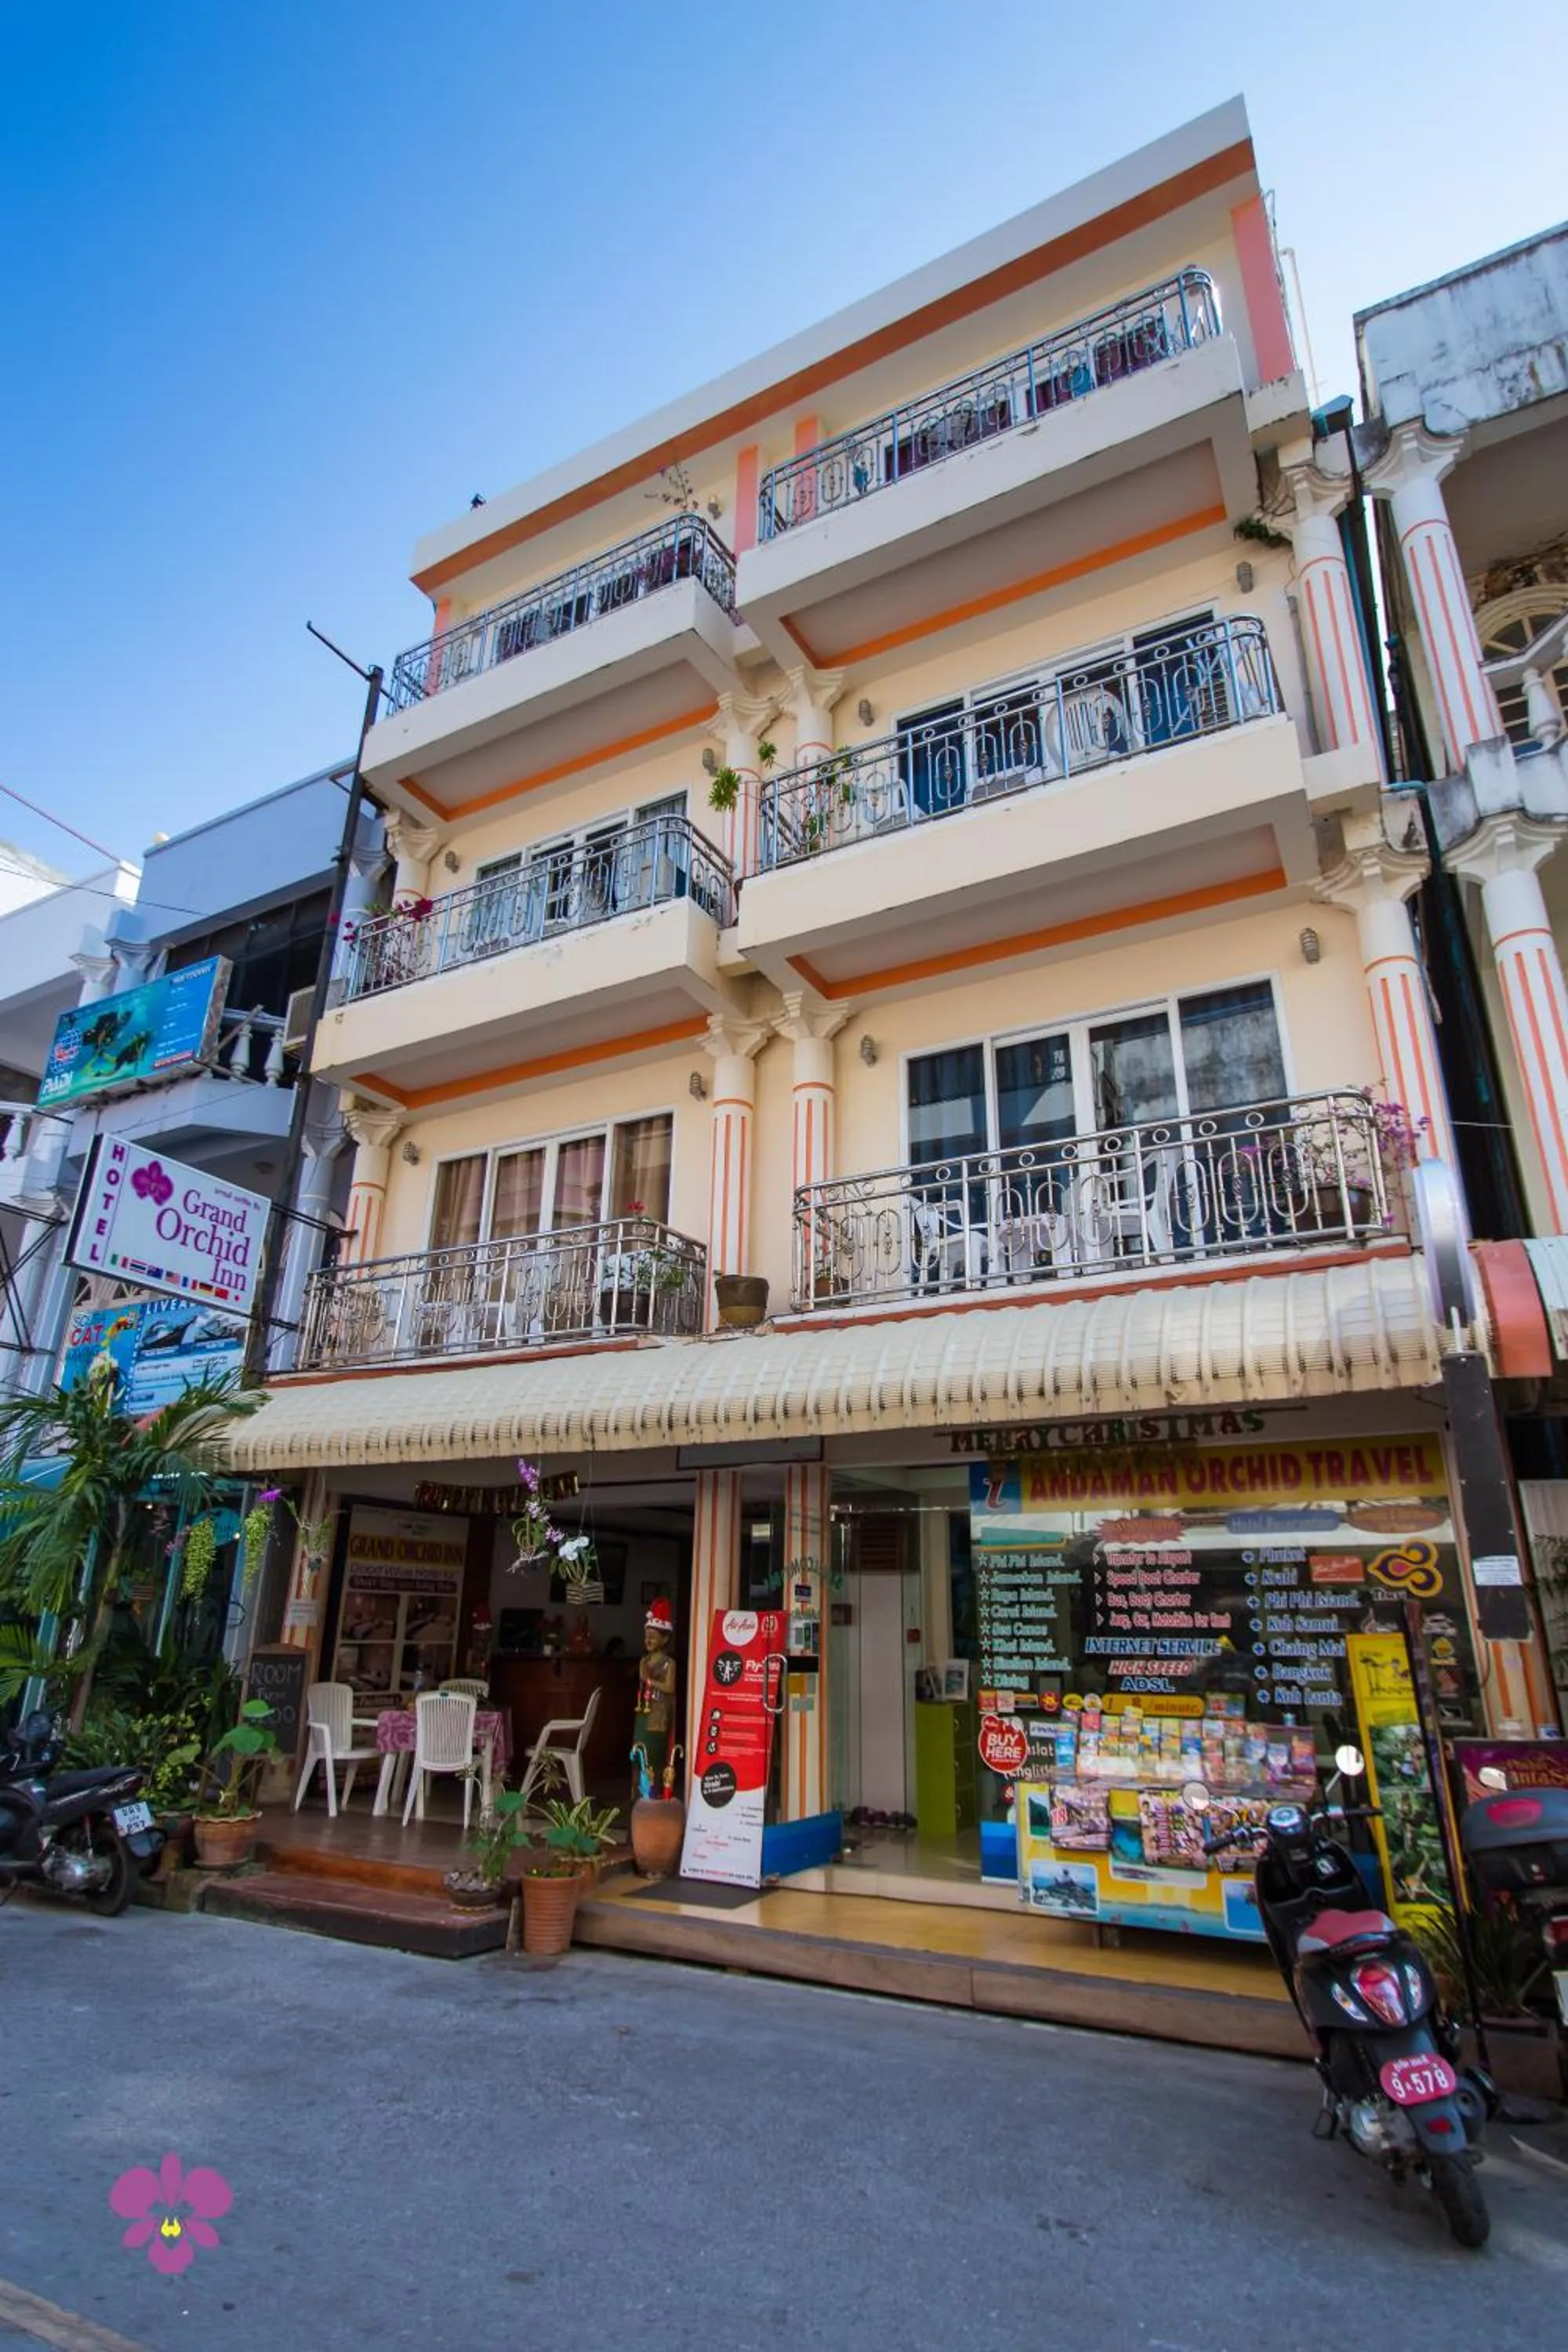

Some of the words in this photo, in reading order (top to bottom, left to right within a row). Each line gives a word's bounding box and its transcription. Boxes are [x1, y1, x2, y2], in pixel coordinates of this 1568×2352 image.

[89, 1144, 125, 1261] HOTEL
[183, 1189, 247, 1233] Grand
[156, 1207, 251, 1268] Orchid
[209, 1258, 247, 1292] Inn
[71, 1324, 103, 1346] CAT
[1030, 1453, 1179, 1502] ANDAMAN
[1182, 1453, 1302, 1495] ORCHID
[1306, 1446, 1434, 1488] TRAVEL
[350, 1534, 393, 1560] GRAND
[1259, 1547, 1306, 1563] Phuket
[989, 1555, 1007, 1568] Phi
[1008, 1555, 1026, 1568] Phi
[1106, 1570, 1137, 1588] Speed
[1265, 1592, 1287, 1608] Phi
[1289, 1592, 1313, 1608] Phi
[1266, 1615, 1294, 1632] Koh
[1085, 1636, 1157, 1654] INTERNET
[1157, 1637, 1222, 1656] SERVICE
[250, 1662, 302, 1685] ROOM
[1109, 1659, 1145, 1675] HIGH
[1146, 1660, 1193, 1676] SPEED
[1272, 1663, 1332, 1685] Bangkok
[1120, 1676, 1176, 1693] ADSL
[1274, 1686, 1302, 1704] Koh
[1304, 1688, 1343, 1706] Lanta
[988, 1733, 1018, 1746] BUY
[986, 1746, 1022, 1759] HERE
